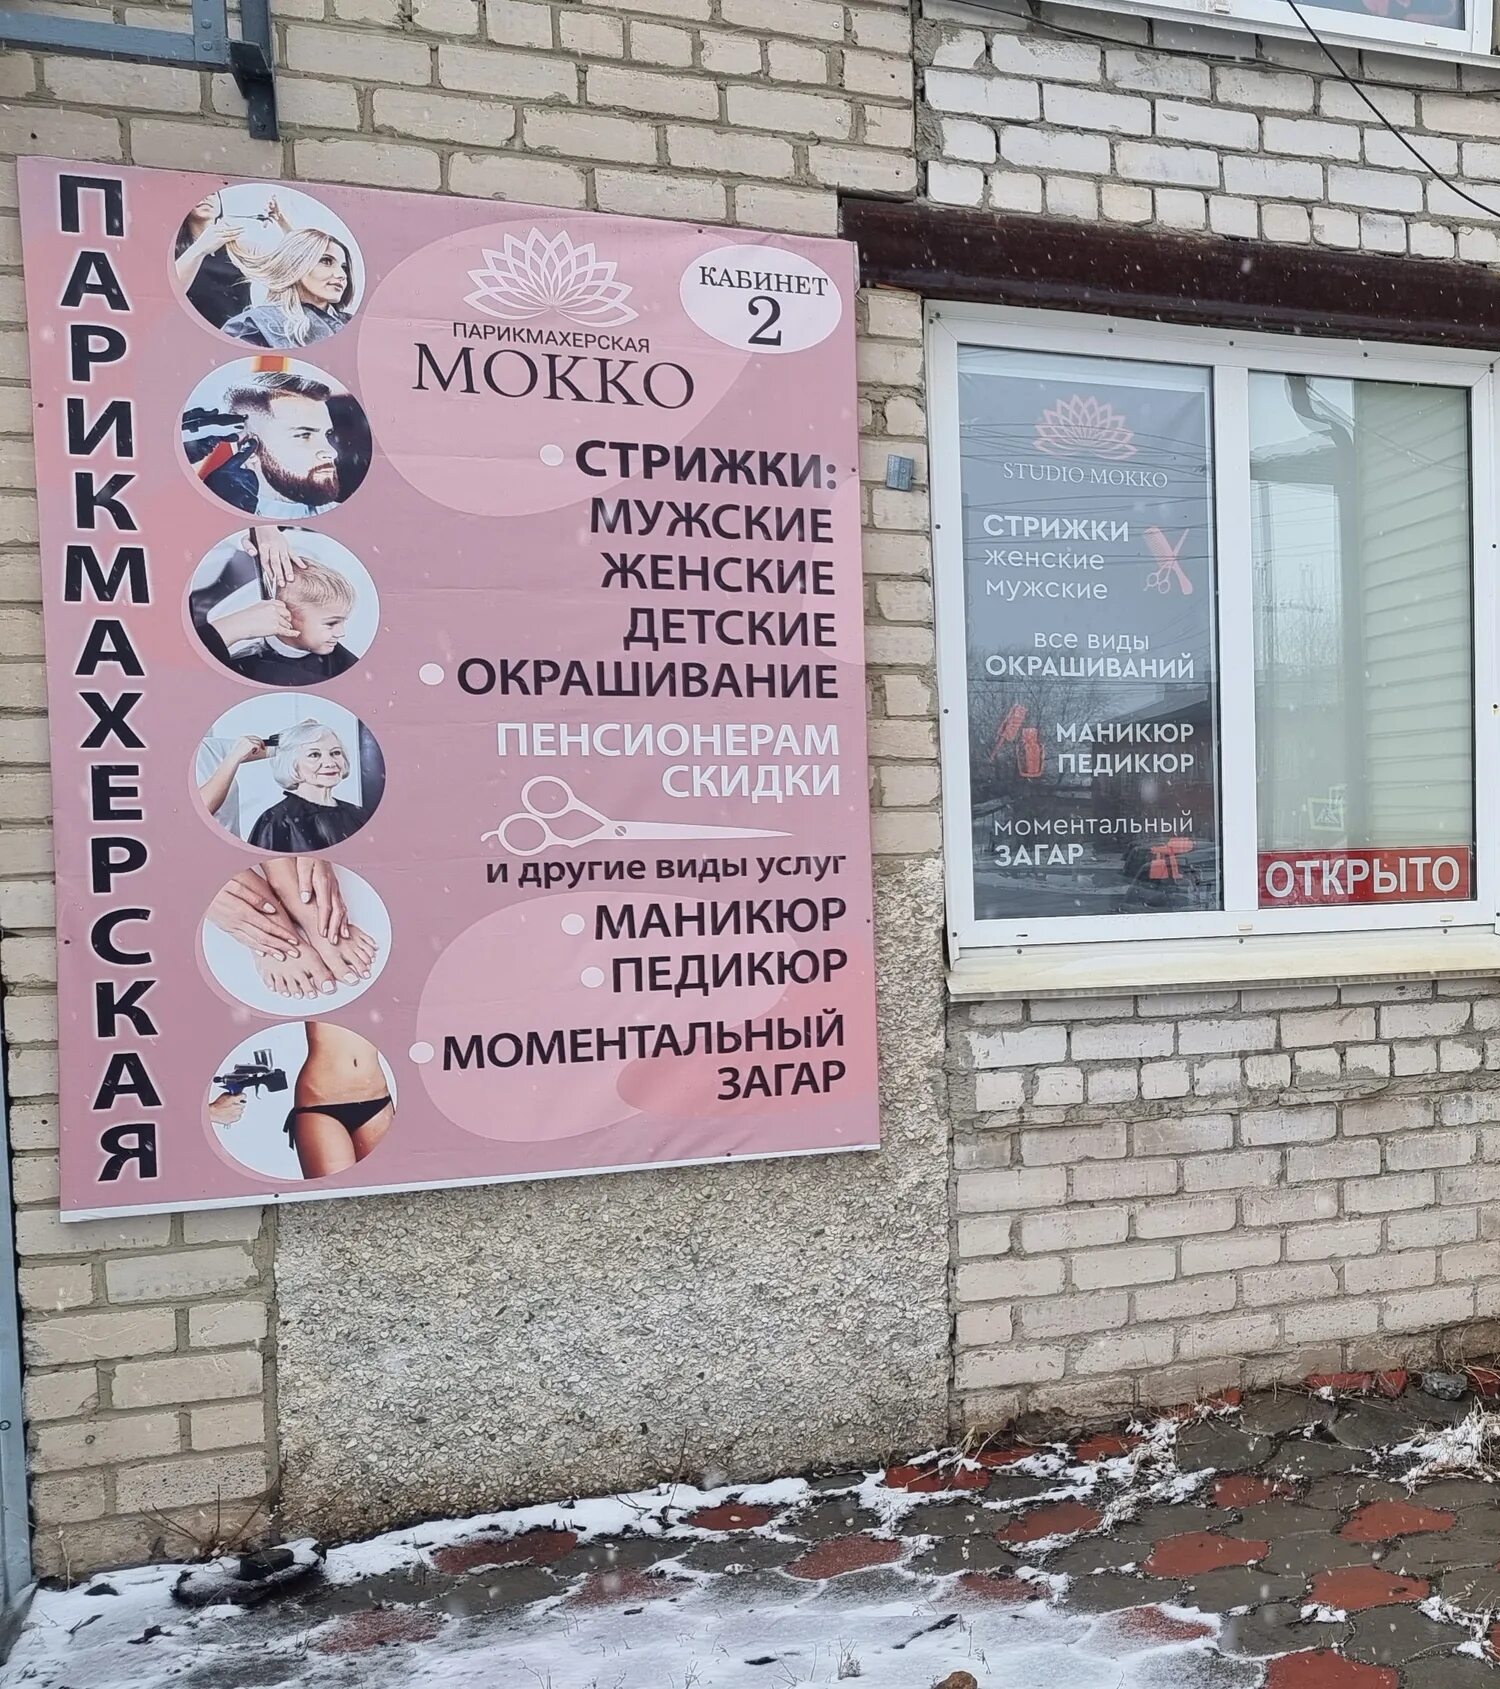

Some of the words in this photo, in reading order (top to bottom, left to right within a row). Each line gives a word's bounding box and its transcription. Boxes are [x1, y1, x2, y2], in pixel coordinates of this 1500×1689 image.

[698, 265, 830, 297] КАБИНЕТ
[452, 322, 651, 354] ПАРИКМАХЕРСКАЯ
[747, 295, 783, 346] 2
[413, 343, 696, 409] МОККО
[576, 440, 838, 489] СТРИЖКИ:
[1003, 462, 1085, 484] STUDIO
[1089, 467, 1168, 489] MOKKO
[590, 497, 834, 543] МУЖСКИЕ
[982, 515, 1129, 543] СТРИЖКИ
[601, 553, 836, 596] ЖЕНСКИЕ
[983, 548, 1105, 571] женские
[984, 580, 1109, 602] мужские
[623, 608, 837, 650] ДЕТСКИЕ
[1034, 632, 1078, 651] все
[1087, 633, 1150, 654] виды
[59, 175, 159, 1183] ПАРИКМАХЕРСКАЯ
[457, 658, 839, 699] ОКРАШИВАНИЕ
[985, 653, 1195, 680] ОКРАШИВАНИЙ
[497, 722, 840, 757] ПЕНСИОНЕРАМ
[1056, 722, 1195, 744] МАНИКЮР
[662, 764, 841, 804] СКИДКИ
[1057, 753, 1195, 777] ПЕДИКЮР
[993, 810, 1193, 837] моментальный
[487, 863, 508, 883] и
[518, 857, 646, 888] другие
[655, 855, 749, 882] виды
[757, 851, 847, 882] услуг
[994, 844, 1083, 867] ЗАГАР
[1265, 855, 1461, 898] ОТКРЫТО
[594, 897, 847, 941] МАНИКЮР
[612, 948, 848, 998] ПЕДИКЮР
[442, 1008, 845, 1071] МОМЕНТАЛЬНЫЙ
[717, 1060, 846, 1101] ЗАГАР
